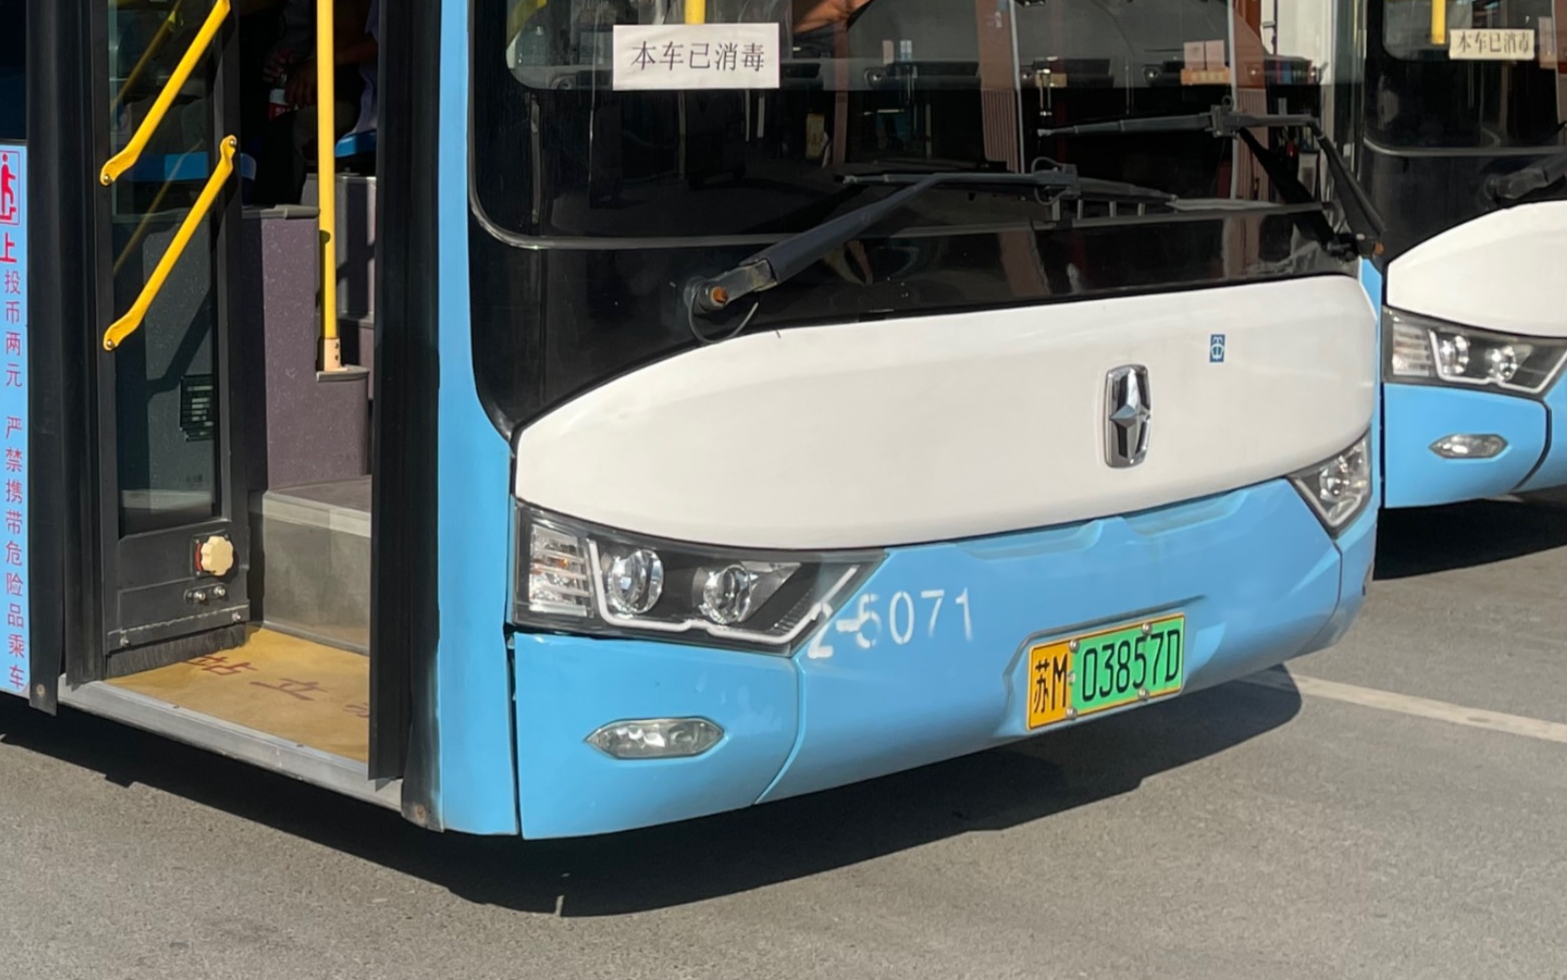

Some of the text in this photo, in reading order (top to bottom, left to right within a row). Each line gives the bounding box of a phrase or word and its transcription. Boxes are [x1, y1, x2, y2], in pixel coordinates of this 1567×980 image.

[631, 40, 765, 73] 本车已消毒
[1458, 31, 1531, 54] 本车已消毒
[4, 269, 26, 690] 投币两元 严禁携带危险品乘车
